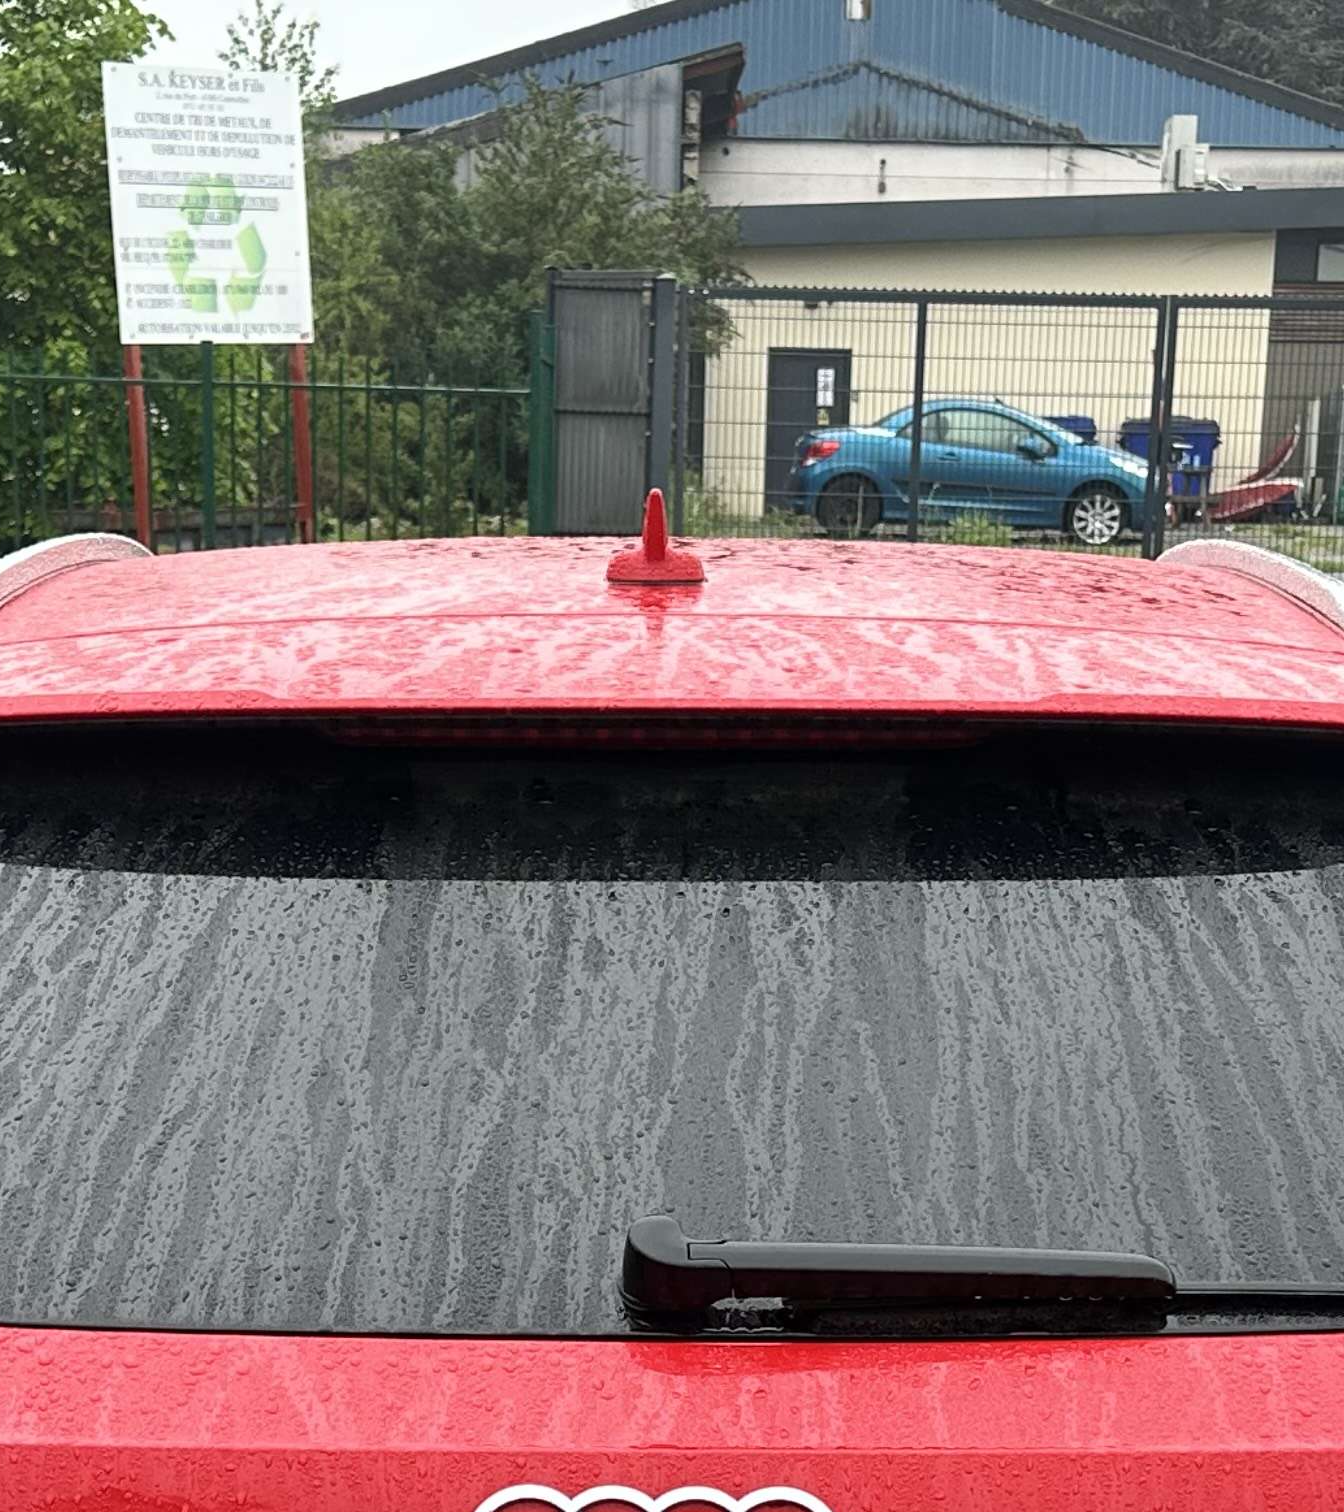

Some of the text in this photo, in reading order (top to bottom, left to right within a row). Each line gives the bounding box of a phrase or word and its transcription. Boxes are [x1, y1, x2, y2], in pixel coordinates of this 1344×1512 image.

[138, 71, 165, 88] S.A.
[168, 70, 225, 90] KEYSER
[242, 78, 265, 92] Fils
